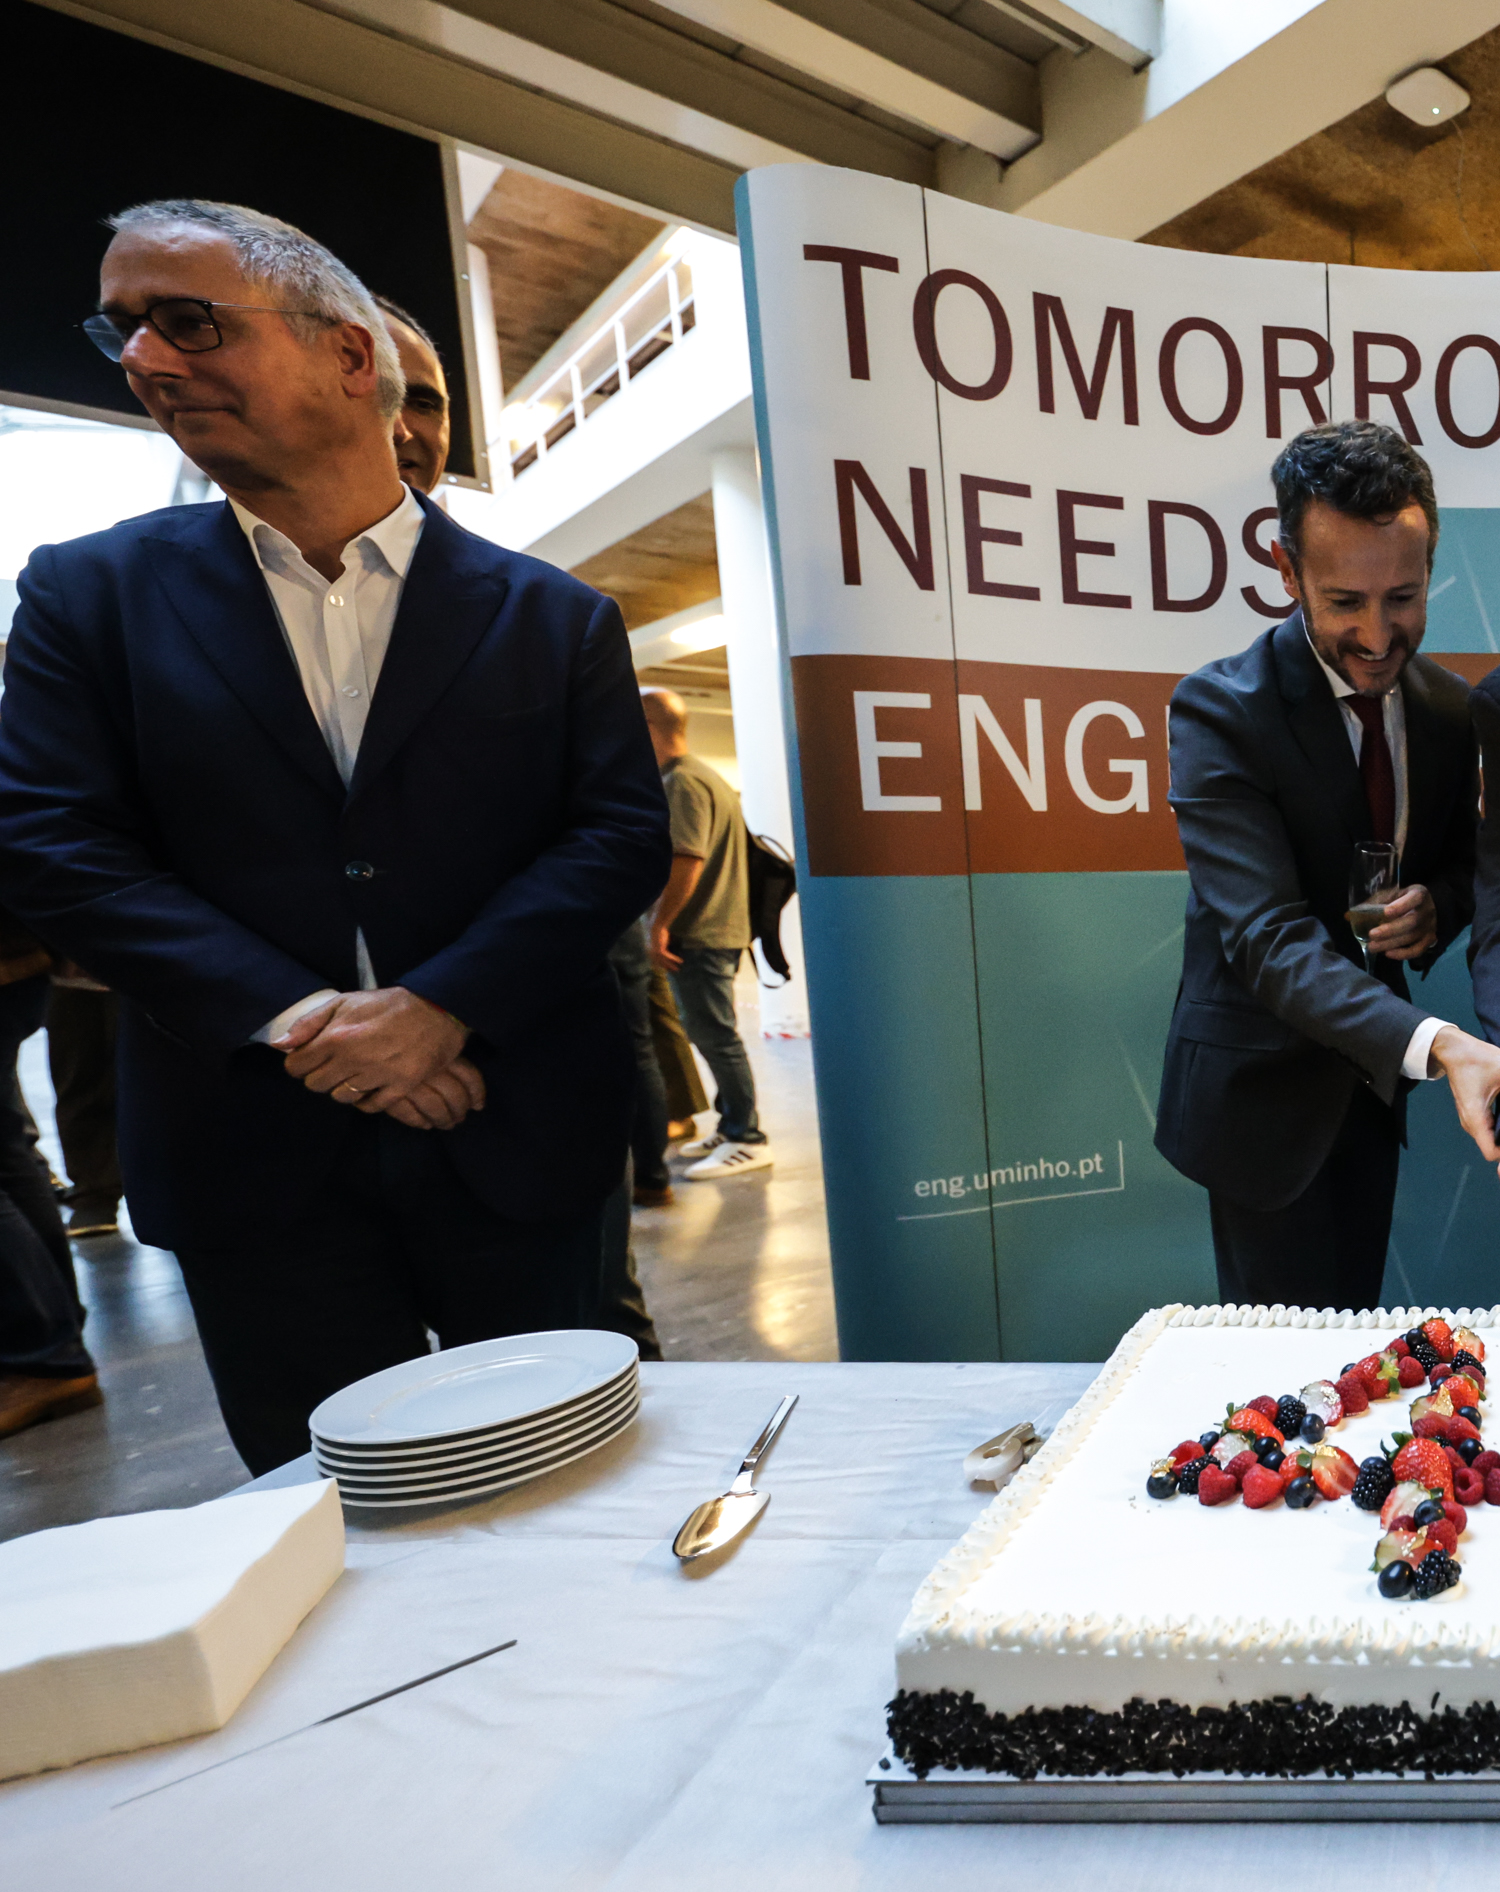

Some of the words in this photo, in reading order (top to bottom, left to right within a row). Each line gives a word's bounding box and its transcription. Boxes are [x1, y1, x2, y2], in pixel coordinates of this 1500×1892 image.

[833, 458, 1300, 619] NEEDS
[852, 690, 1176, 814] ENG
[914, 1152, 1104, 1198] eng.uminho.pt
